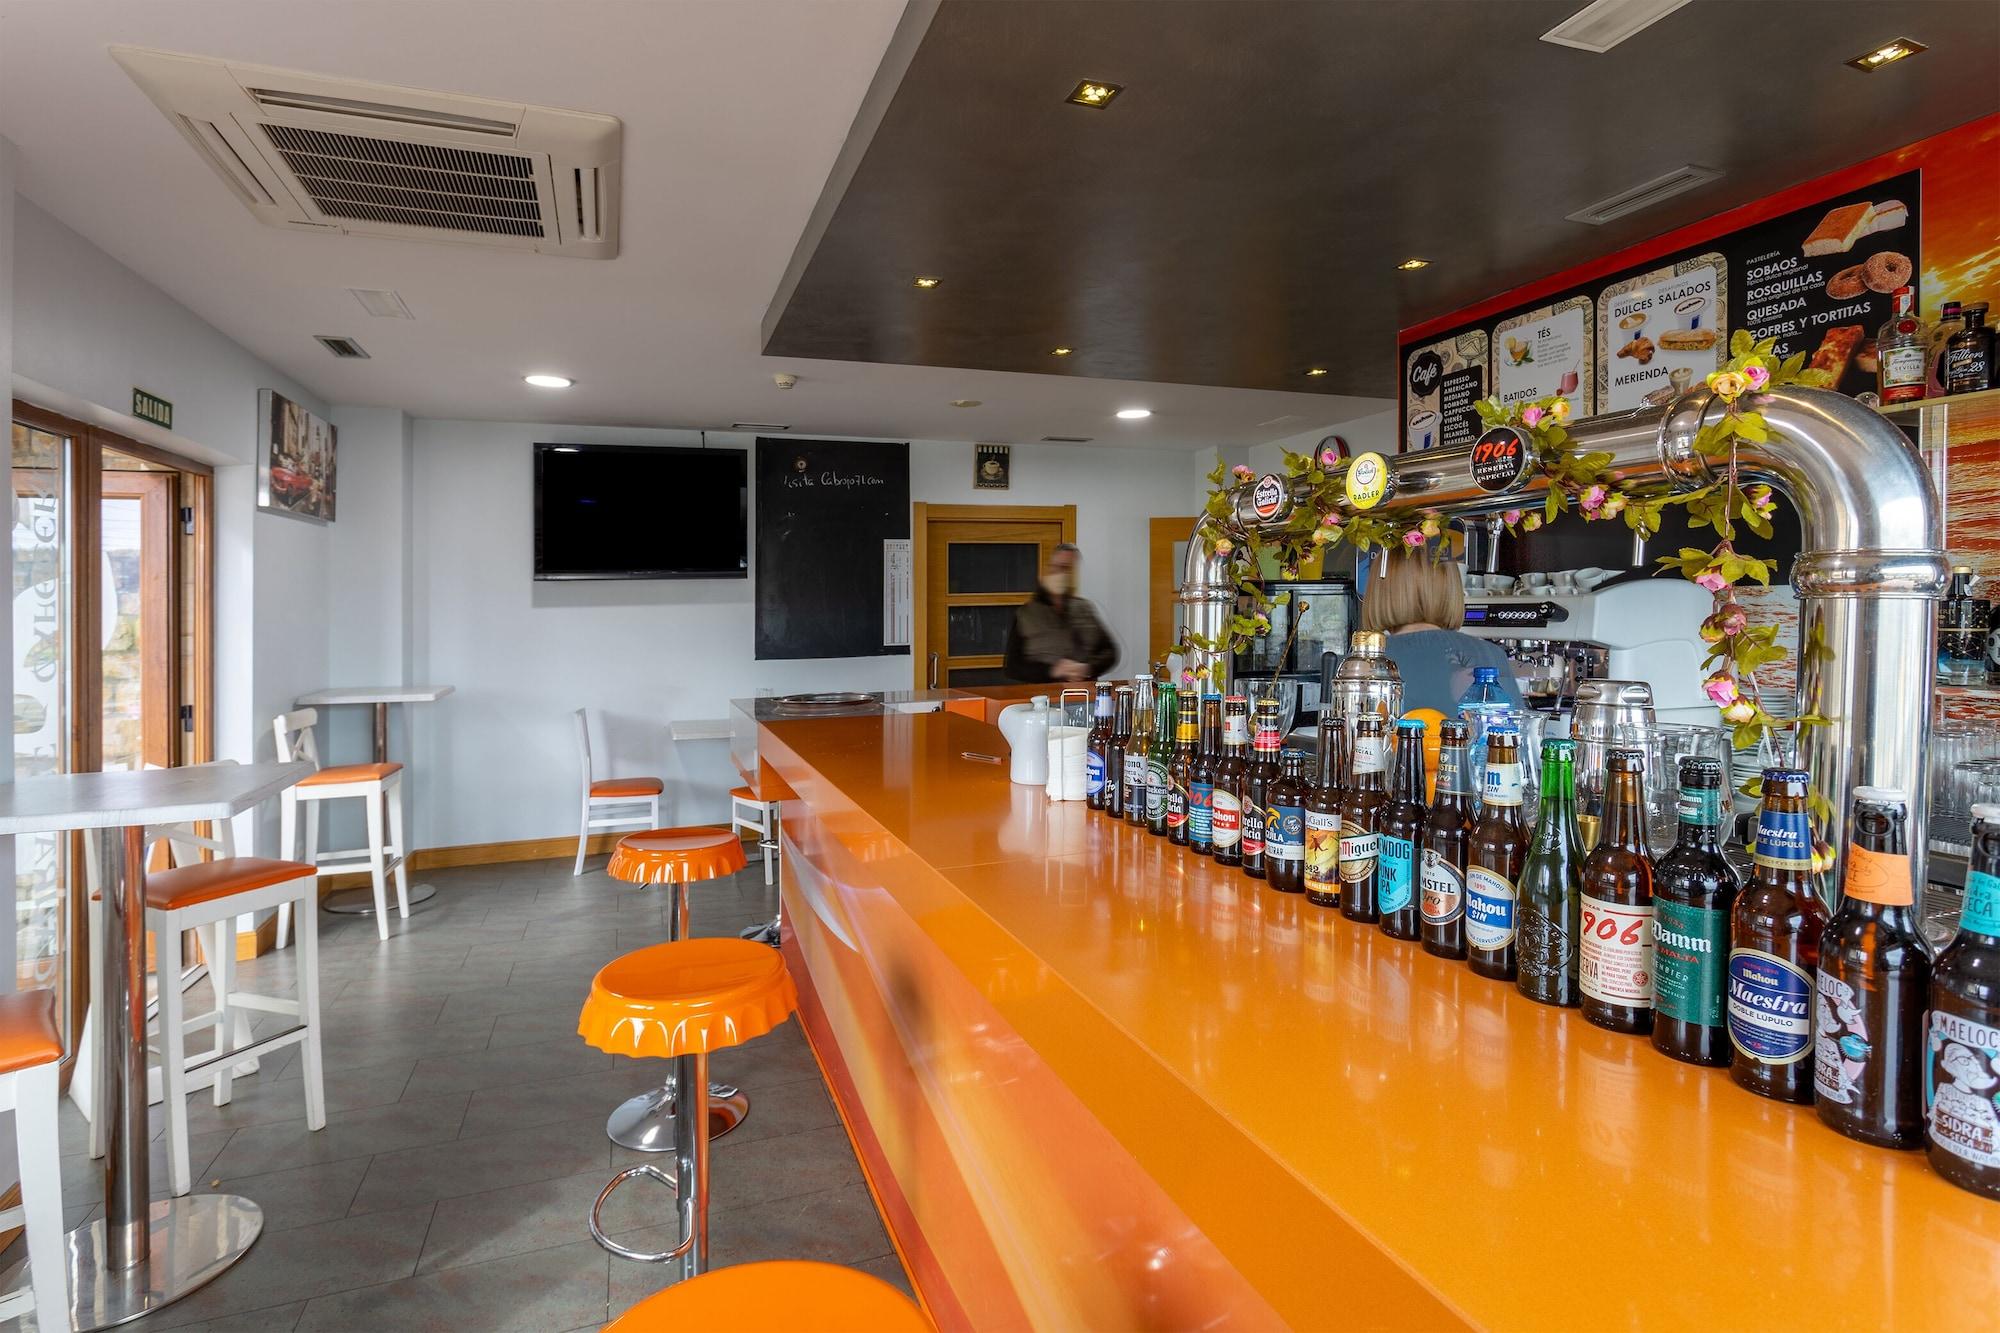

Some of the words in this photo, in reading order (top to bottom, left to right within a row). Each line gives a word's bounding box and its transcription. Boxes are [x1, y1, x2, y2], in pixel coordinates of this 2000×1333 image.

[1746, 250, 1781, 266] PASTELERÍA
[1746, 256, 1798, 281] SOBAOS
[1746, 270, 1823, 301] ROSQUILLAS
[1614, 298, 1653, 318] DULCES
[1658, 281, 1711, 305] SALADOS
[1746, 296, 1807, 322] QUESADA
[1749, 320, 1795, 341] GOFRES
[1799, 316, 1808, 329] Y
[1811, 301, 1871, 326] TORTITAS
[1537, 327, 1551, 339] TÉS
[1949, 348, 1984, 364] Filliers
[1412, 362, 1438, 386] Café
[1967, 361, 1985, 372] 28
[1443, 375, 1470, 388] ESPRESSO
[1614, 366, 1669, 387] MERIENDA
[1443, 381, 1478, 395] AMERICANO
[1443, 390, 1470, 402] MEDIANO
[1503, 387, 1537, 402] BATIDOS
[135, 393, 170, 425] SALIDA
[1443, 397, 1469, 410] BOMBÓN
[1443, 404, 1474, 417] CAPPUCCI
[1443, 420, 1469, 432] ESCOCÉS
[1443, 428, 1470, 439] IRLANDÉS
[1475, 438, 1519, 463] 1906
[1476, 462, 1514, 474] RESERVA
[1476, 470, 1516, 484] ESPECIAL
[1256, 488, 1278, 499] Estrella
[1353, 489, 1380, 500] RADLER
[1341, 836, 1379, 857] Miguel
[1769, 837, 1805, 849] LÚPULO
[1422, 876, 1455, 894] MSTEL
[1483, 876, 1505, 892] MAHOU
[1471, 909, 1488, 922] SIN
[1581, 908, 1644, 946] 906
[1652, 919, 1712, 954] Damm
[1742, 967, 1779, 987] Mahou
[1729, 977, 1808, 1015] Maestra
[1733, 1002, 1755, 1018] DOBLE
[1756, 1013, 1793, 1027] LÚPULO
[1939, 1015, 2000, 1048] MAELOC
[1941, 1113, 1982, 1141] SIDRA
[1949, 1132, 1974, 1148] SECA
